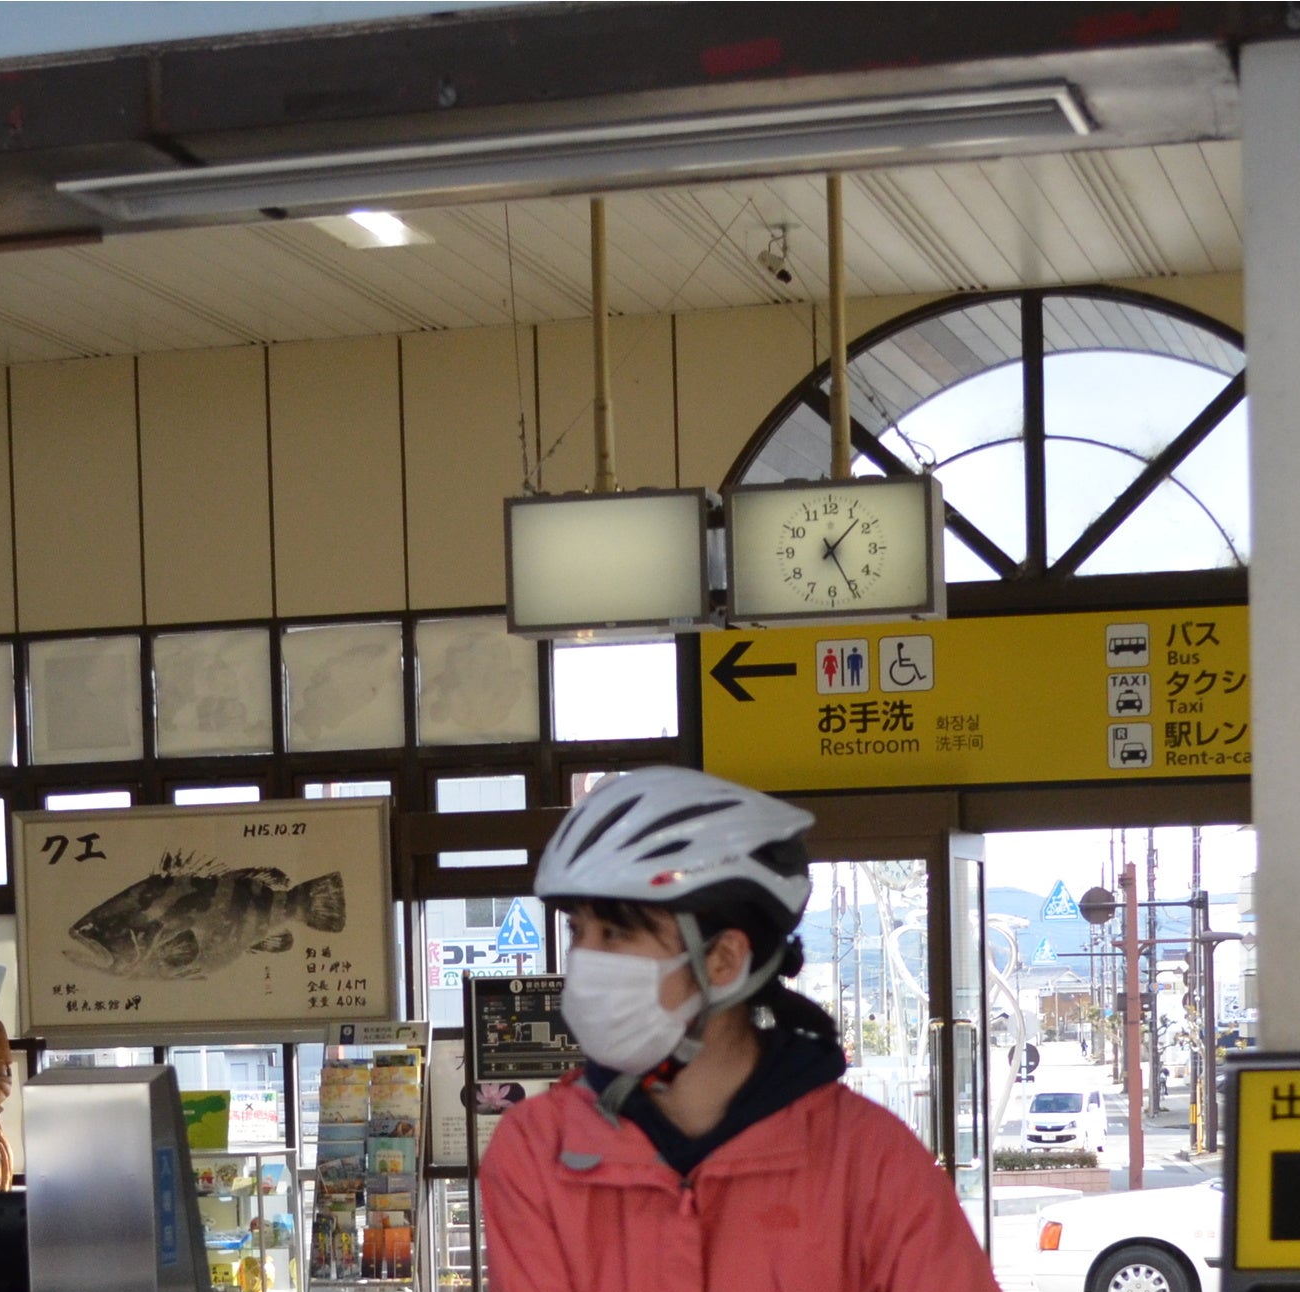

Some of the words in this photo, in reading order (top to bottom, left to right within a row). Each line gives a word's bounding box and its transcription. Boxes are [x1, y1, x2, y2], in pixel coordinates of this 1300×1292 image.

[823, 503, 838, 515] 12
[848, 508, 854, 519] 1
[805, 511, 818, 522] 11
[791, 527, 806, 538] 10
[861, 522, 871, 534] 2
[785, 547, 795, 559] 9
[868, 542, 878, 554] 3
[792, 567, 802, 580] 8
[861, 564, 870, 576] 4
[807, 582, 817, 594] 7
[828, 586, 837, 598] 6
[1166, 621, 1220, 647] バス
[1167, 651, 1200, 665] Bus
[1111, 675, 1147, 687] TAXI
[1166, 670, 1247, 697] タクシ
[1167, 698, 1203, 714] Taxi
[818, 700, 914, 734] お手洗
[935, 714, 980, 732] 화장실
[1164, 721, 1248, 748] 駅レン
[820, 738, 920, 756] Restroom
[935, 734, 984, 751] 洗手间
[243, 823, 307, 837] H15.10.27
[41, 832, 107, 865] クエ
[307, 980, 329, 993] 全長
[308, 996, 329, 1009] 重量
